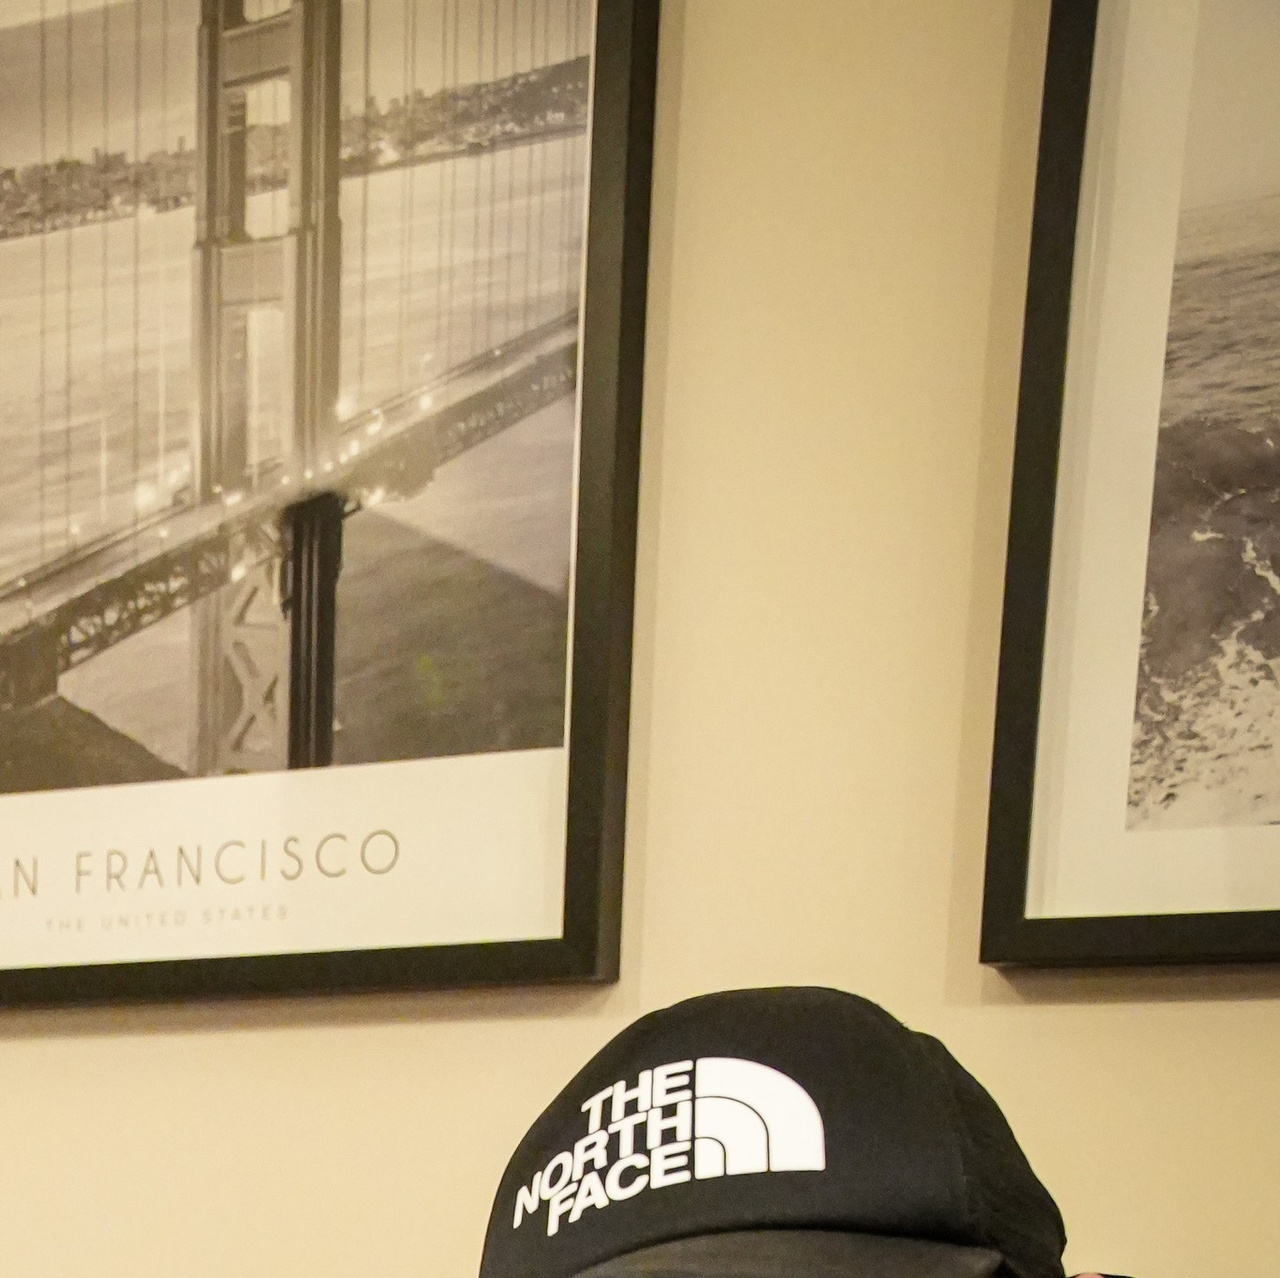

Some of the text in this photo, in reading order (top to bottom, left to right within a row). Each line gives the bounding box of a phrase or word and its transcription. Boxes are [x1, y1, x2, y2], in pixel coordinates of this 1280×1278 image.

[74, 828, 401, 895] FRANCISCO
[45, 902, 289, 934] THE UNITED STATES
[580, 1058, 695, 1135] THE
[512, 1099, 695, 1230] NORTH
[545, 1140, 693, 1237] FACE
